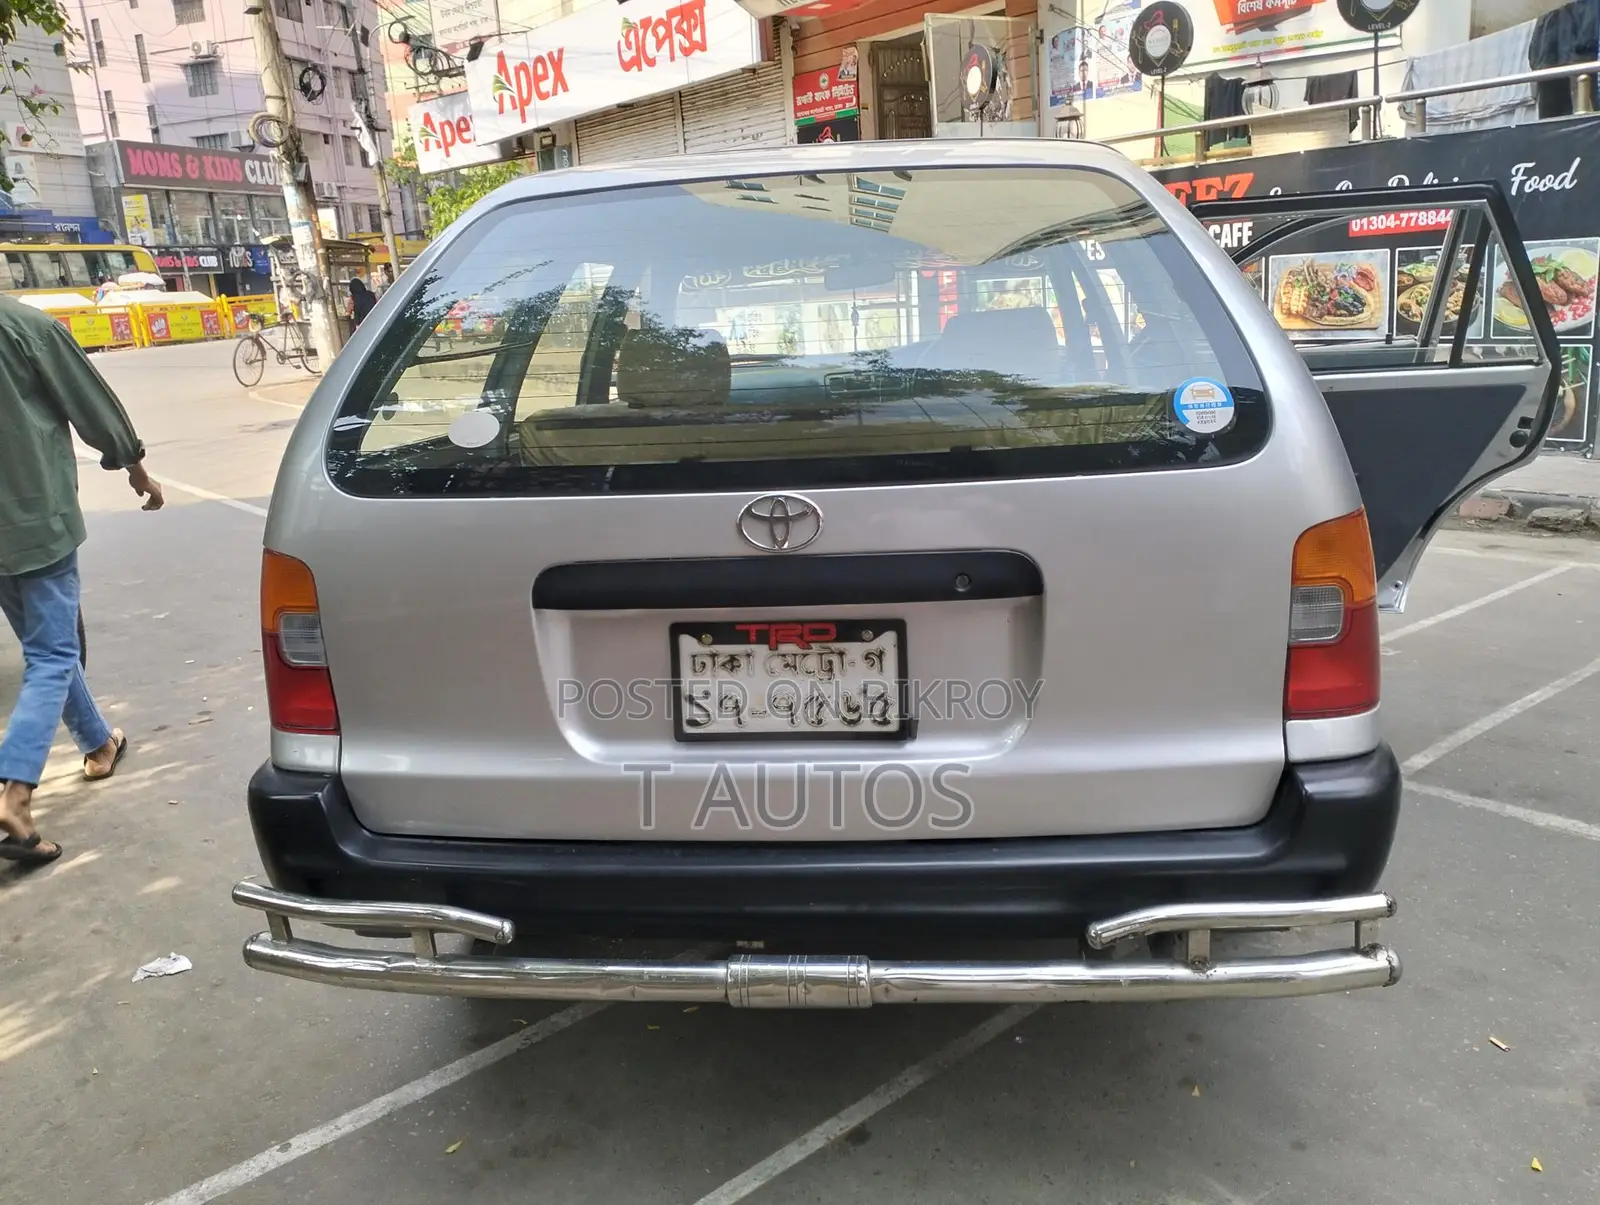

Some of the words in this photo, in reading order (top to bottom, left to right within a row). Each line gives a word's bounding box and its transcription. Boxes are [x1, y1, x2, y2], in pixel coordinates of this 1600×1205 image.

[496, 46, 569, 124] Apex
[423, 111, 473, 158] Ape
[127, 149, 182, 179] MOMS
[186, 155, 200, 180] &
[202, 156, 243, 182] KIDS
[1511, 157, 1580, 196] Food
[199, 256, 218, 267] CLUB
[734, 623, 837, 650] TRD
[691, 648, 754, 677] ঢাকা
